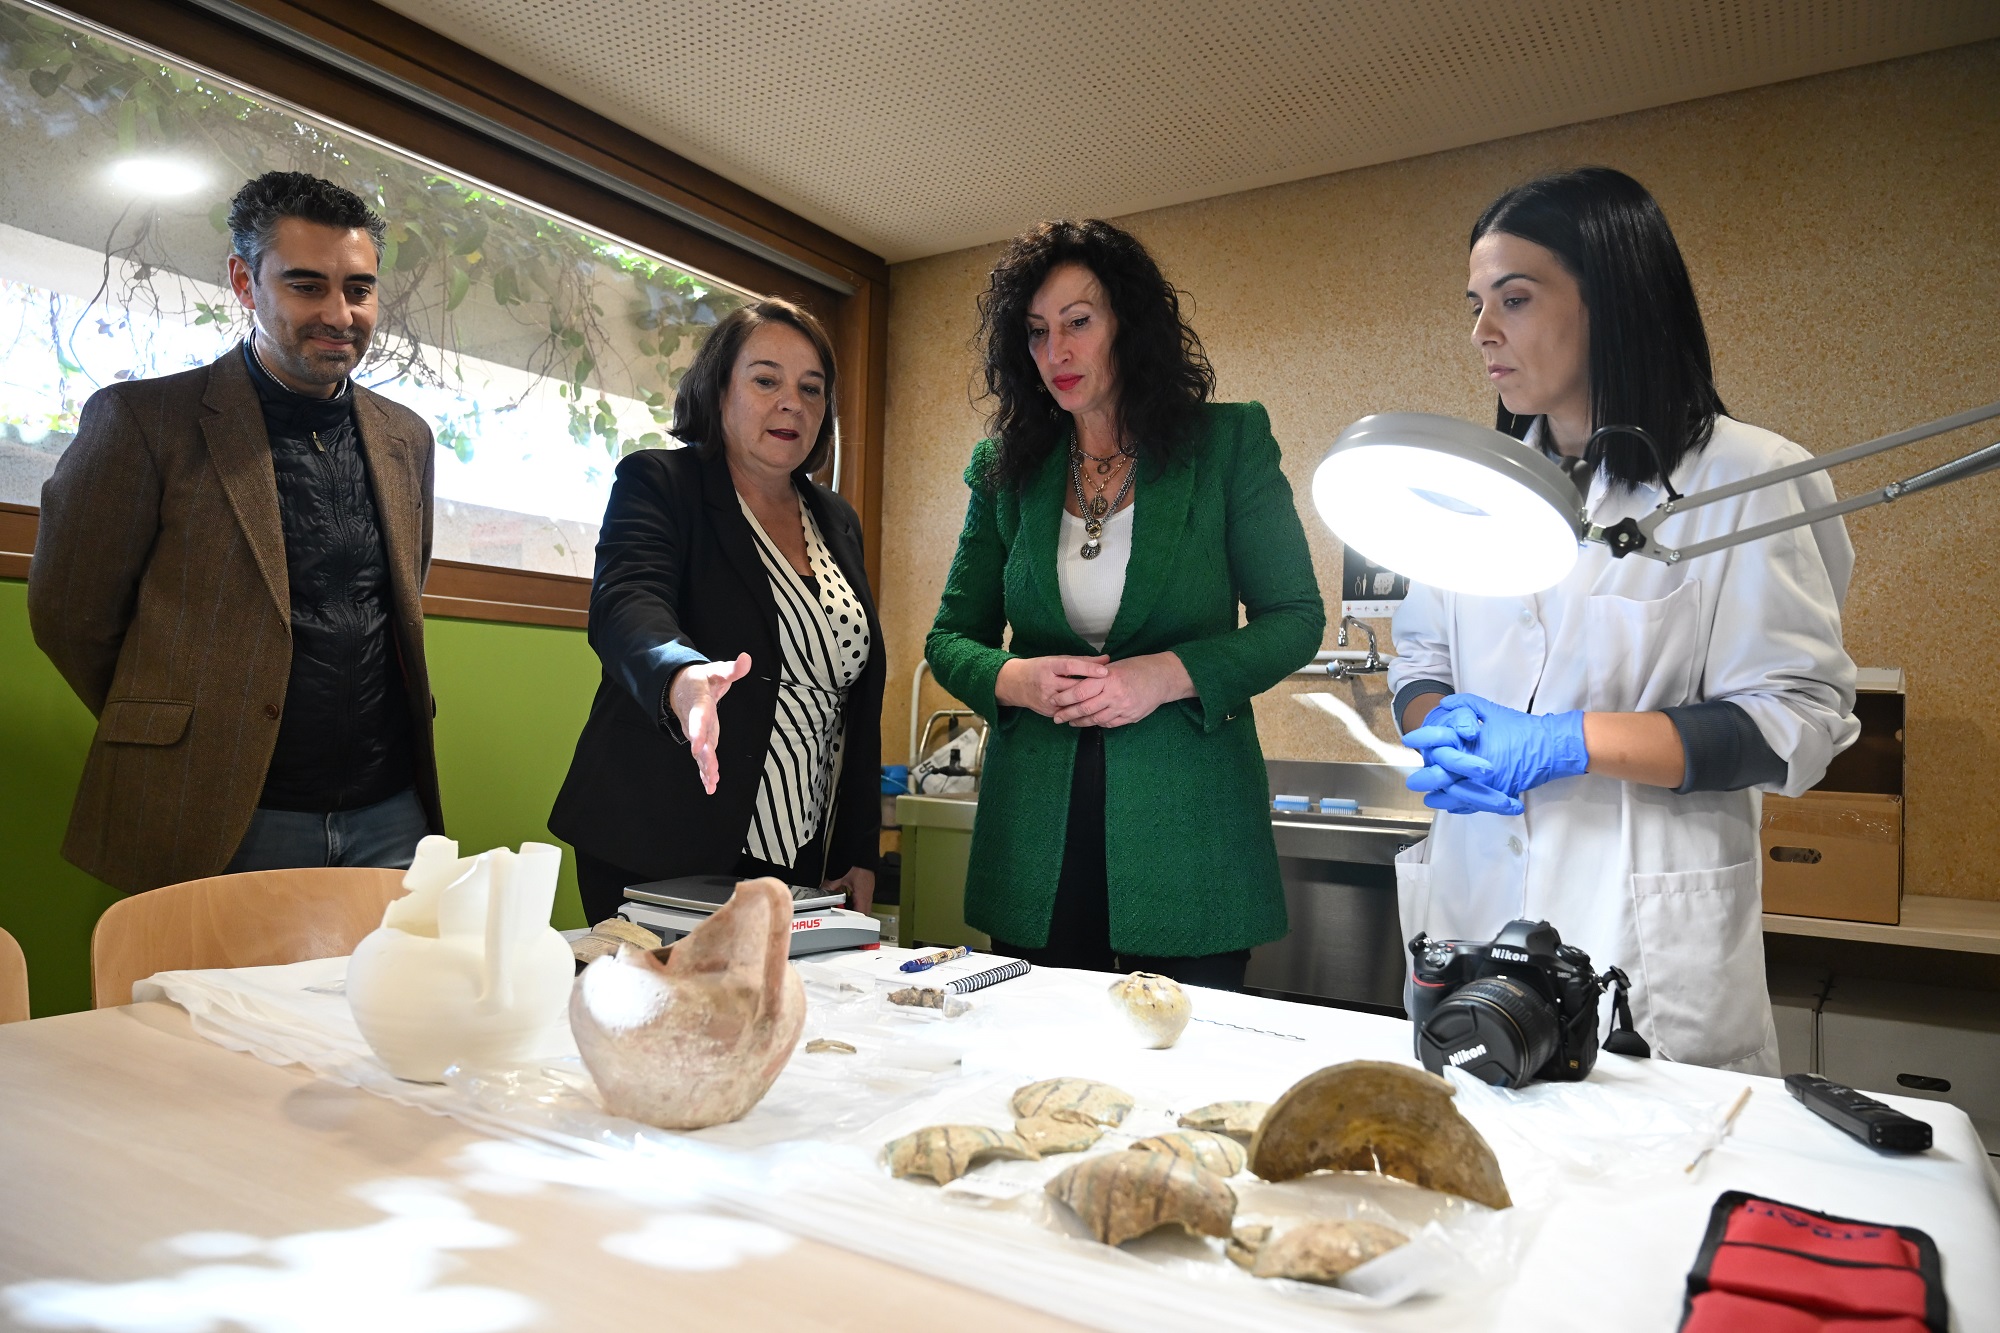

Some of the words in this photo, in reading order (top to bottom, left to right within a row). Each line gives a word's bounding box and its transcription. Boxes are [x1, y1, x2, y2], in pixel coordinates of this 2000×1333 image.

[791, 918, 821, 931] HAUS
[1490, 947, 1529, 963] Nikon
[1448, 1043, 1487, 1067] Nikon
